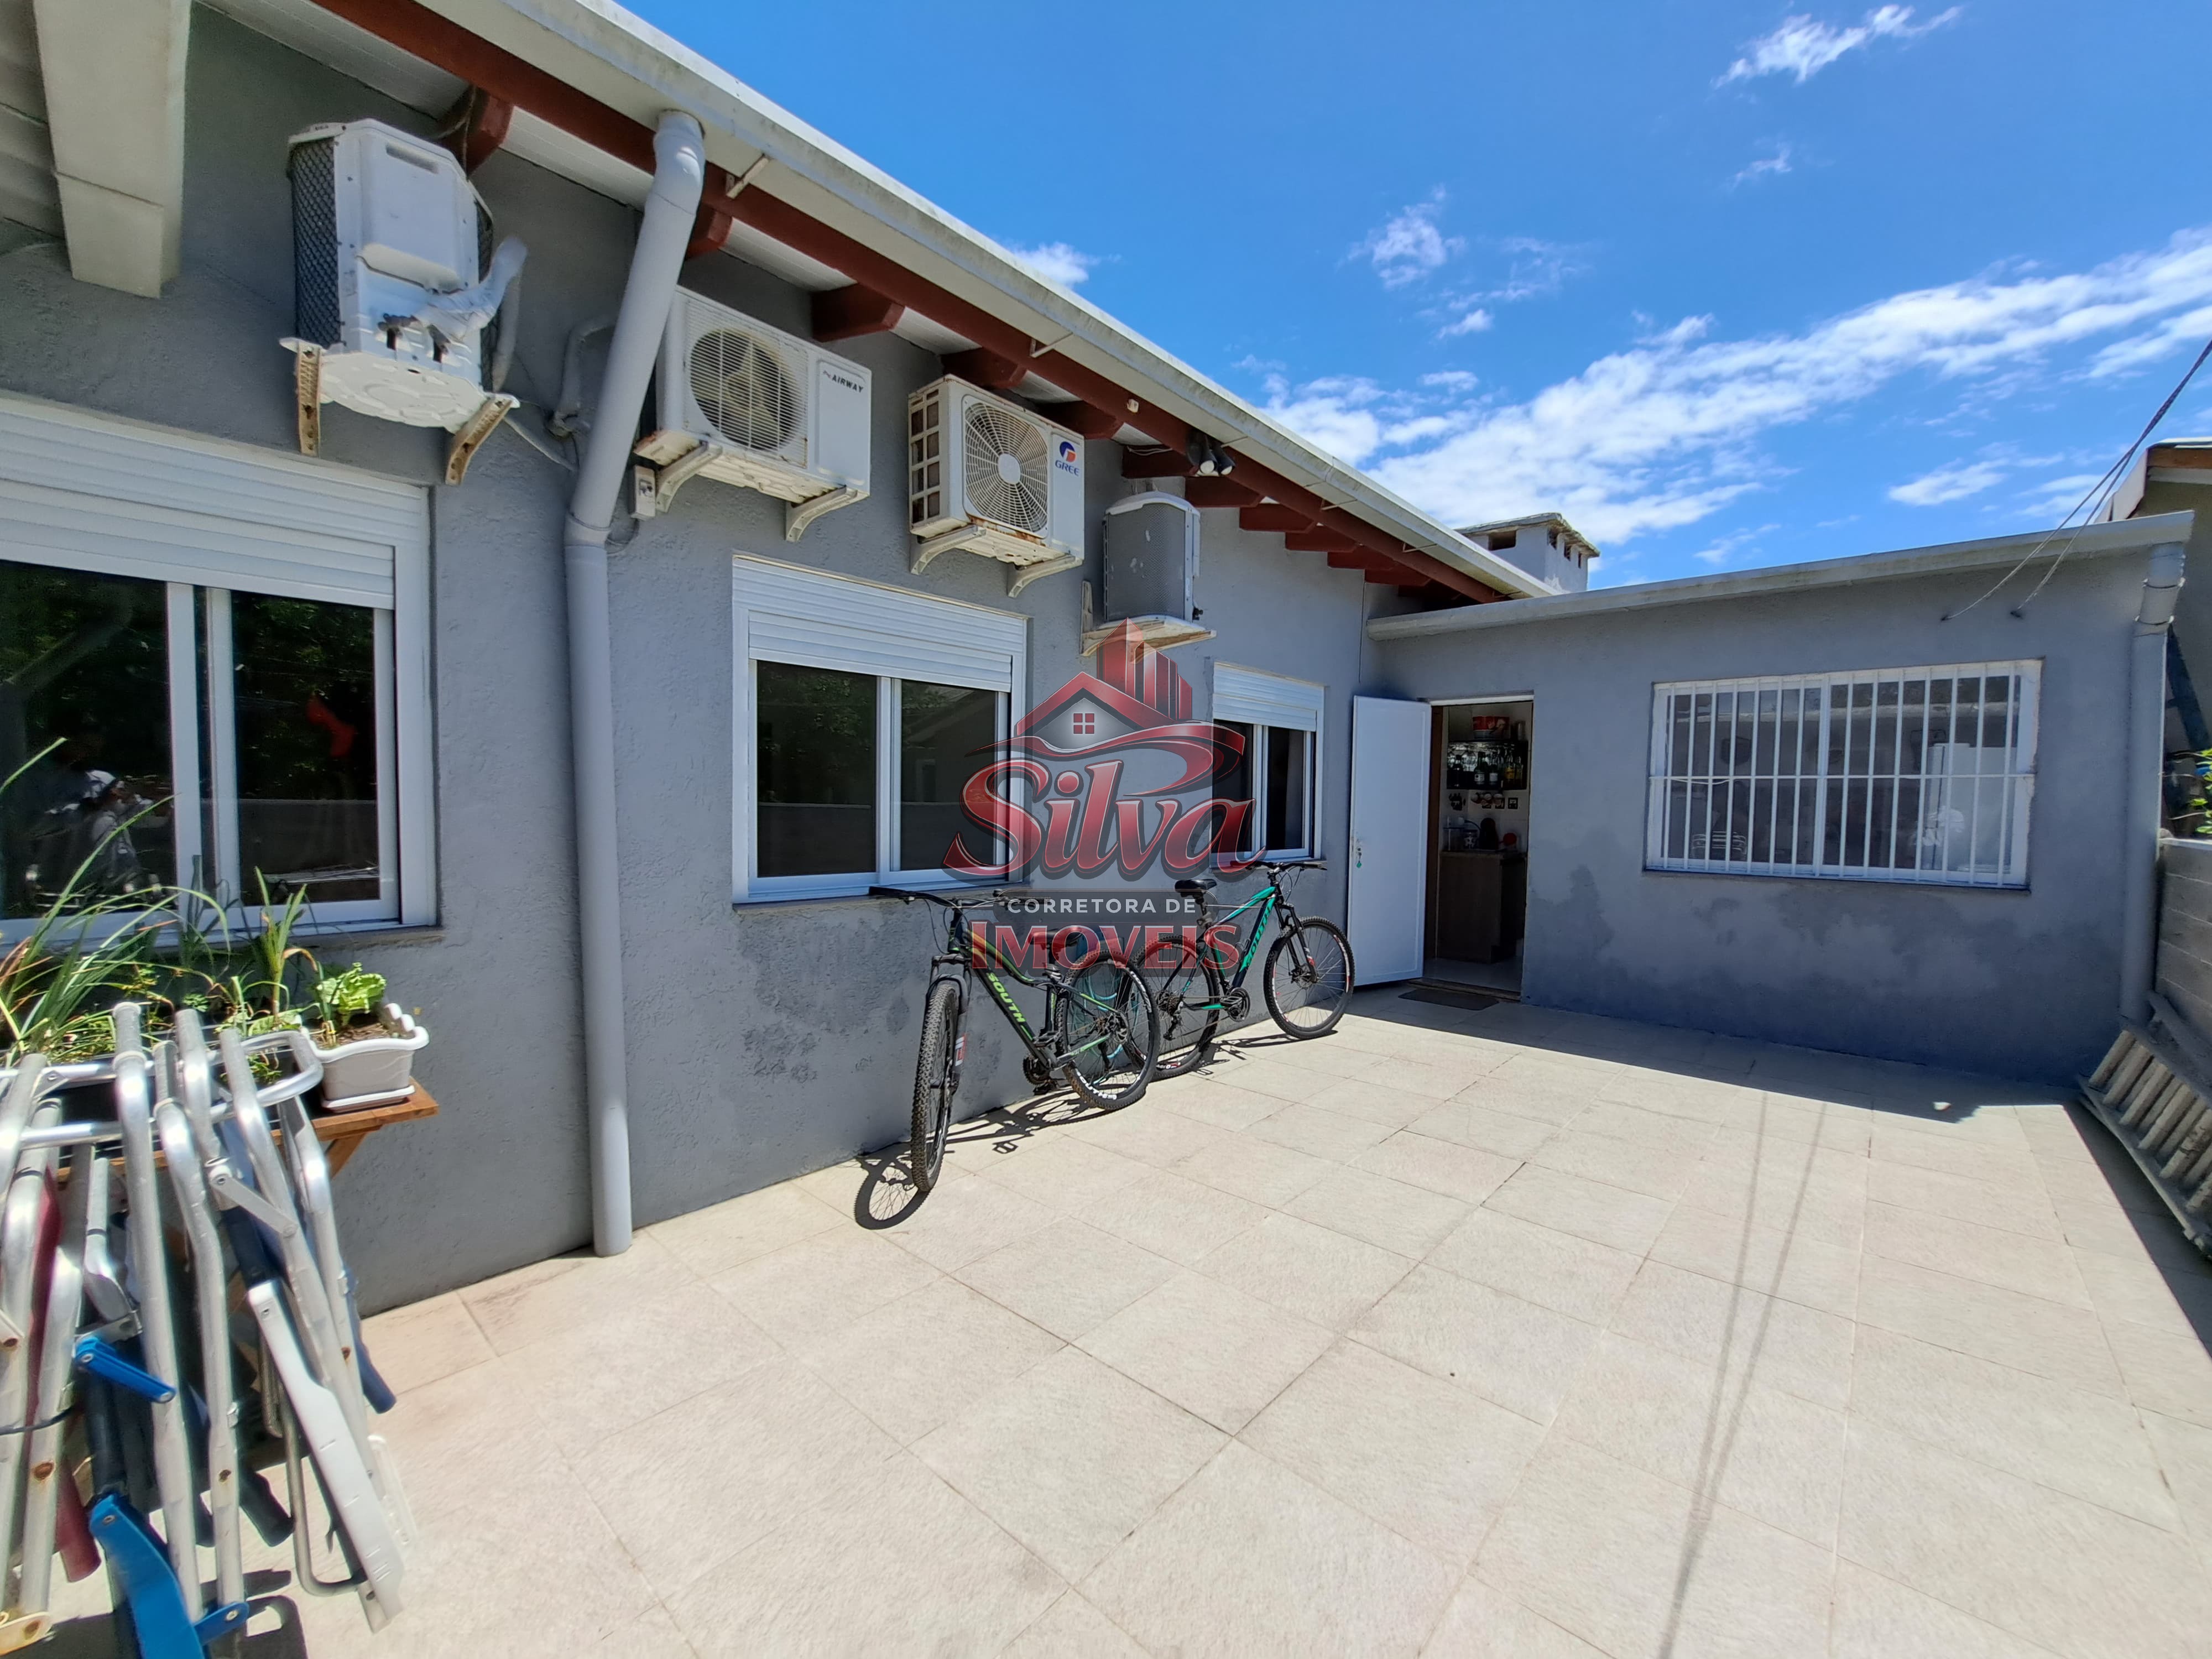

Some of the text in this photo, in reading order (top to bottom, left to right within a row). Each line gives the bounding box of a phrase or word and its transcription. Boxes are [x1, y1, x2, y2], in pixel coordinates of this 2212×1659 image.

[832, 374, 864, 393] AIRWAY
[1055, 460, 1080, 477] GREE
[986, 972, 1026, 1023] SOUTH
